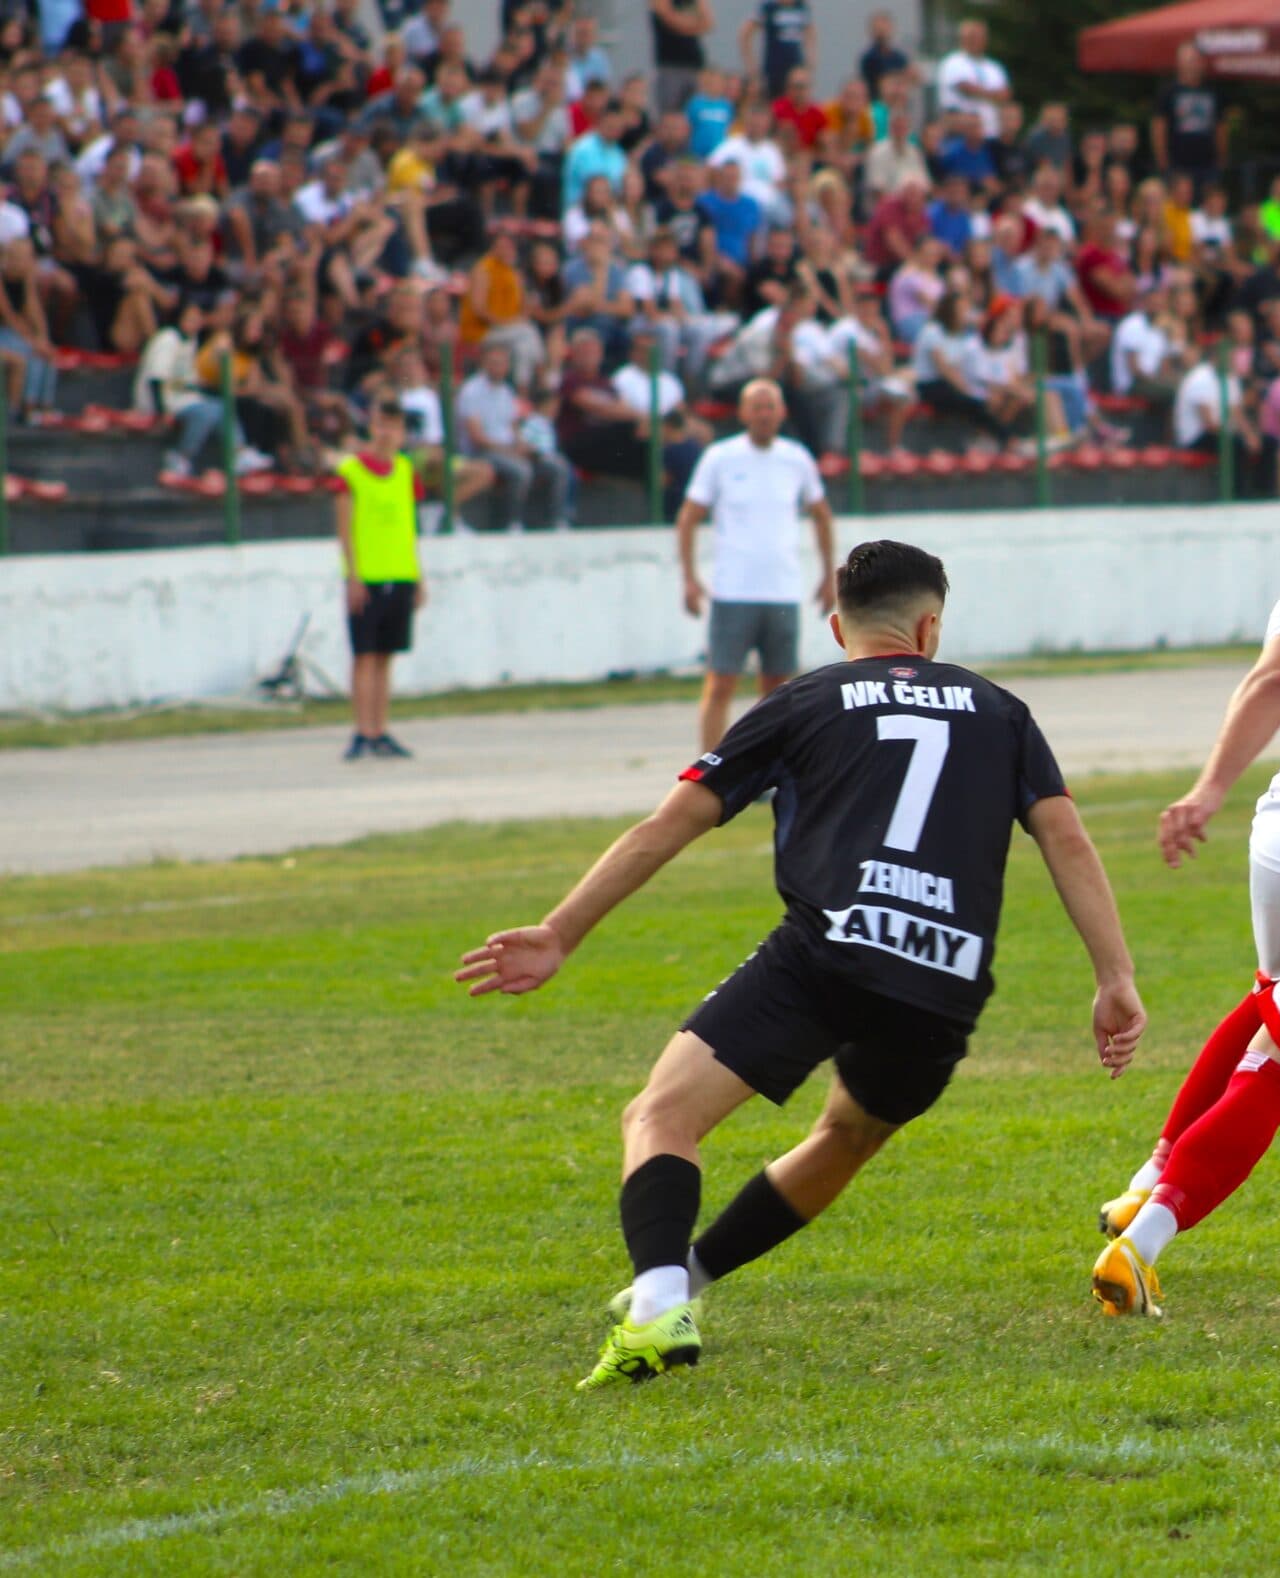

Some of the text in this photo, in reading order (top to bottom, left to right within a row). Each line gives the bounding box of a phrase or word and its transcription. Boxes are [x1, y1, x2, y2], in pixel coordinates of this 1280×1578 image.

[840, 680, 976, 712] NK ČELIK
[876, 714, 950, 852] 7
[857, 859, 955, 914] ZENICA
[843, 909, 969, 967] ALMY
